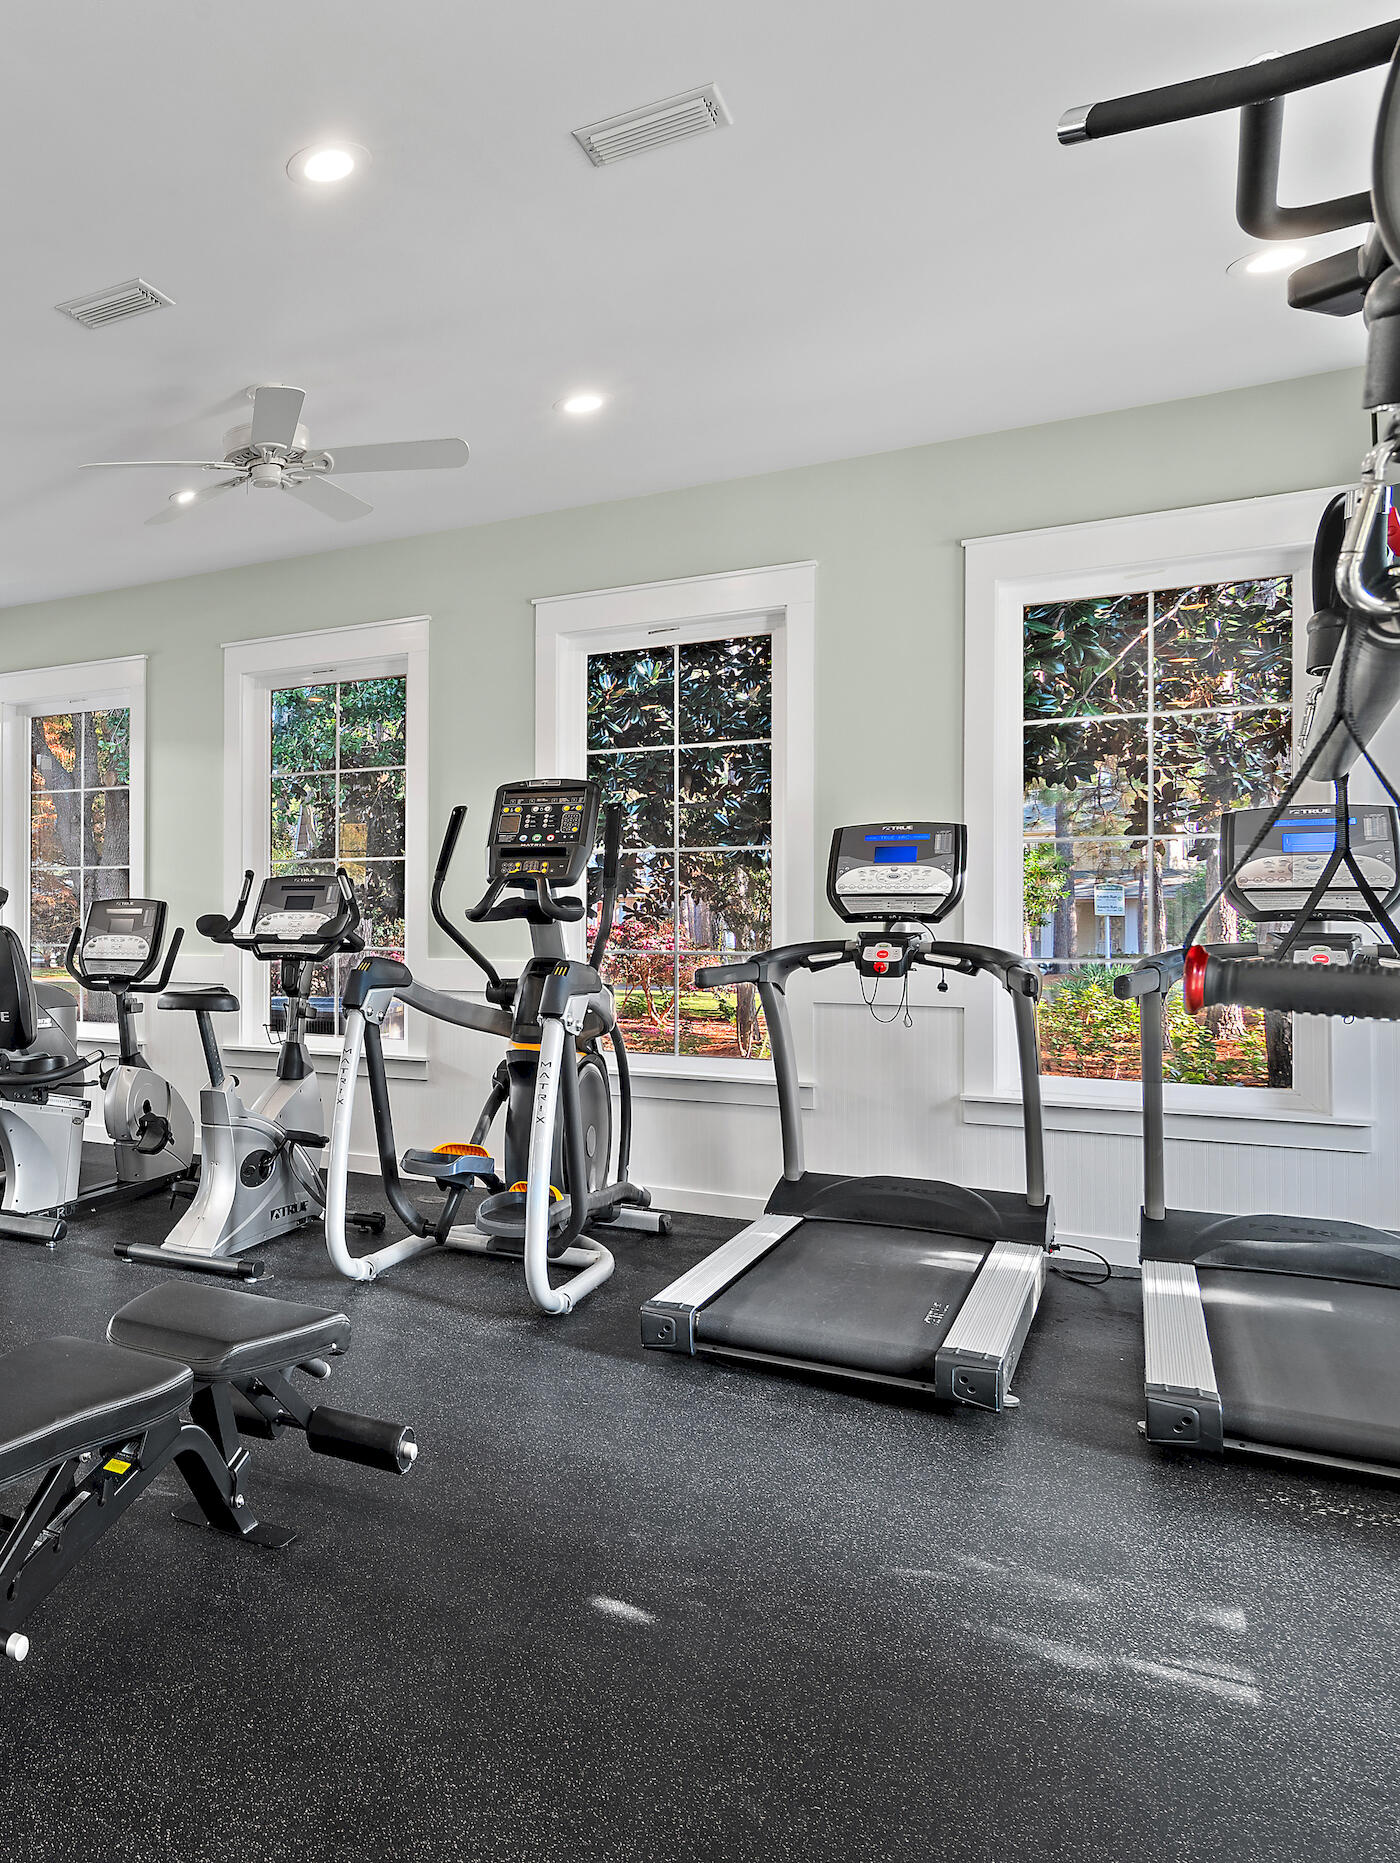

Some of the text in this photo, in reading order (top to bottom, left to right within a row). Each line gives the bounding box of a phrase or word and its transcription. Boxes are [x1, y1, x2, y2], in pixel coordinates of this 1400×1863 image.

[336, 1048, 352, 1105] MATRIX
[535, 1061, 552, 1124] MATRIX
[281, 1200, 309, 1217] TRUE
